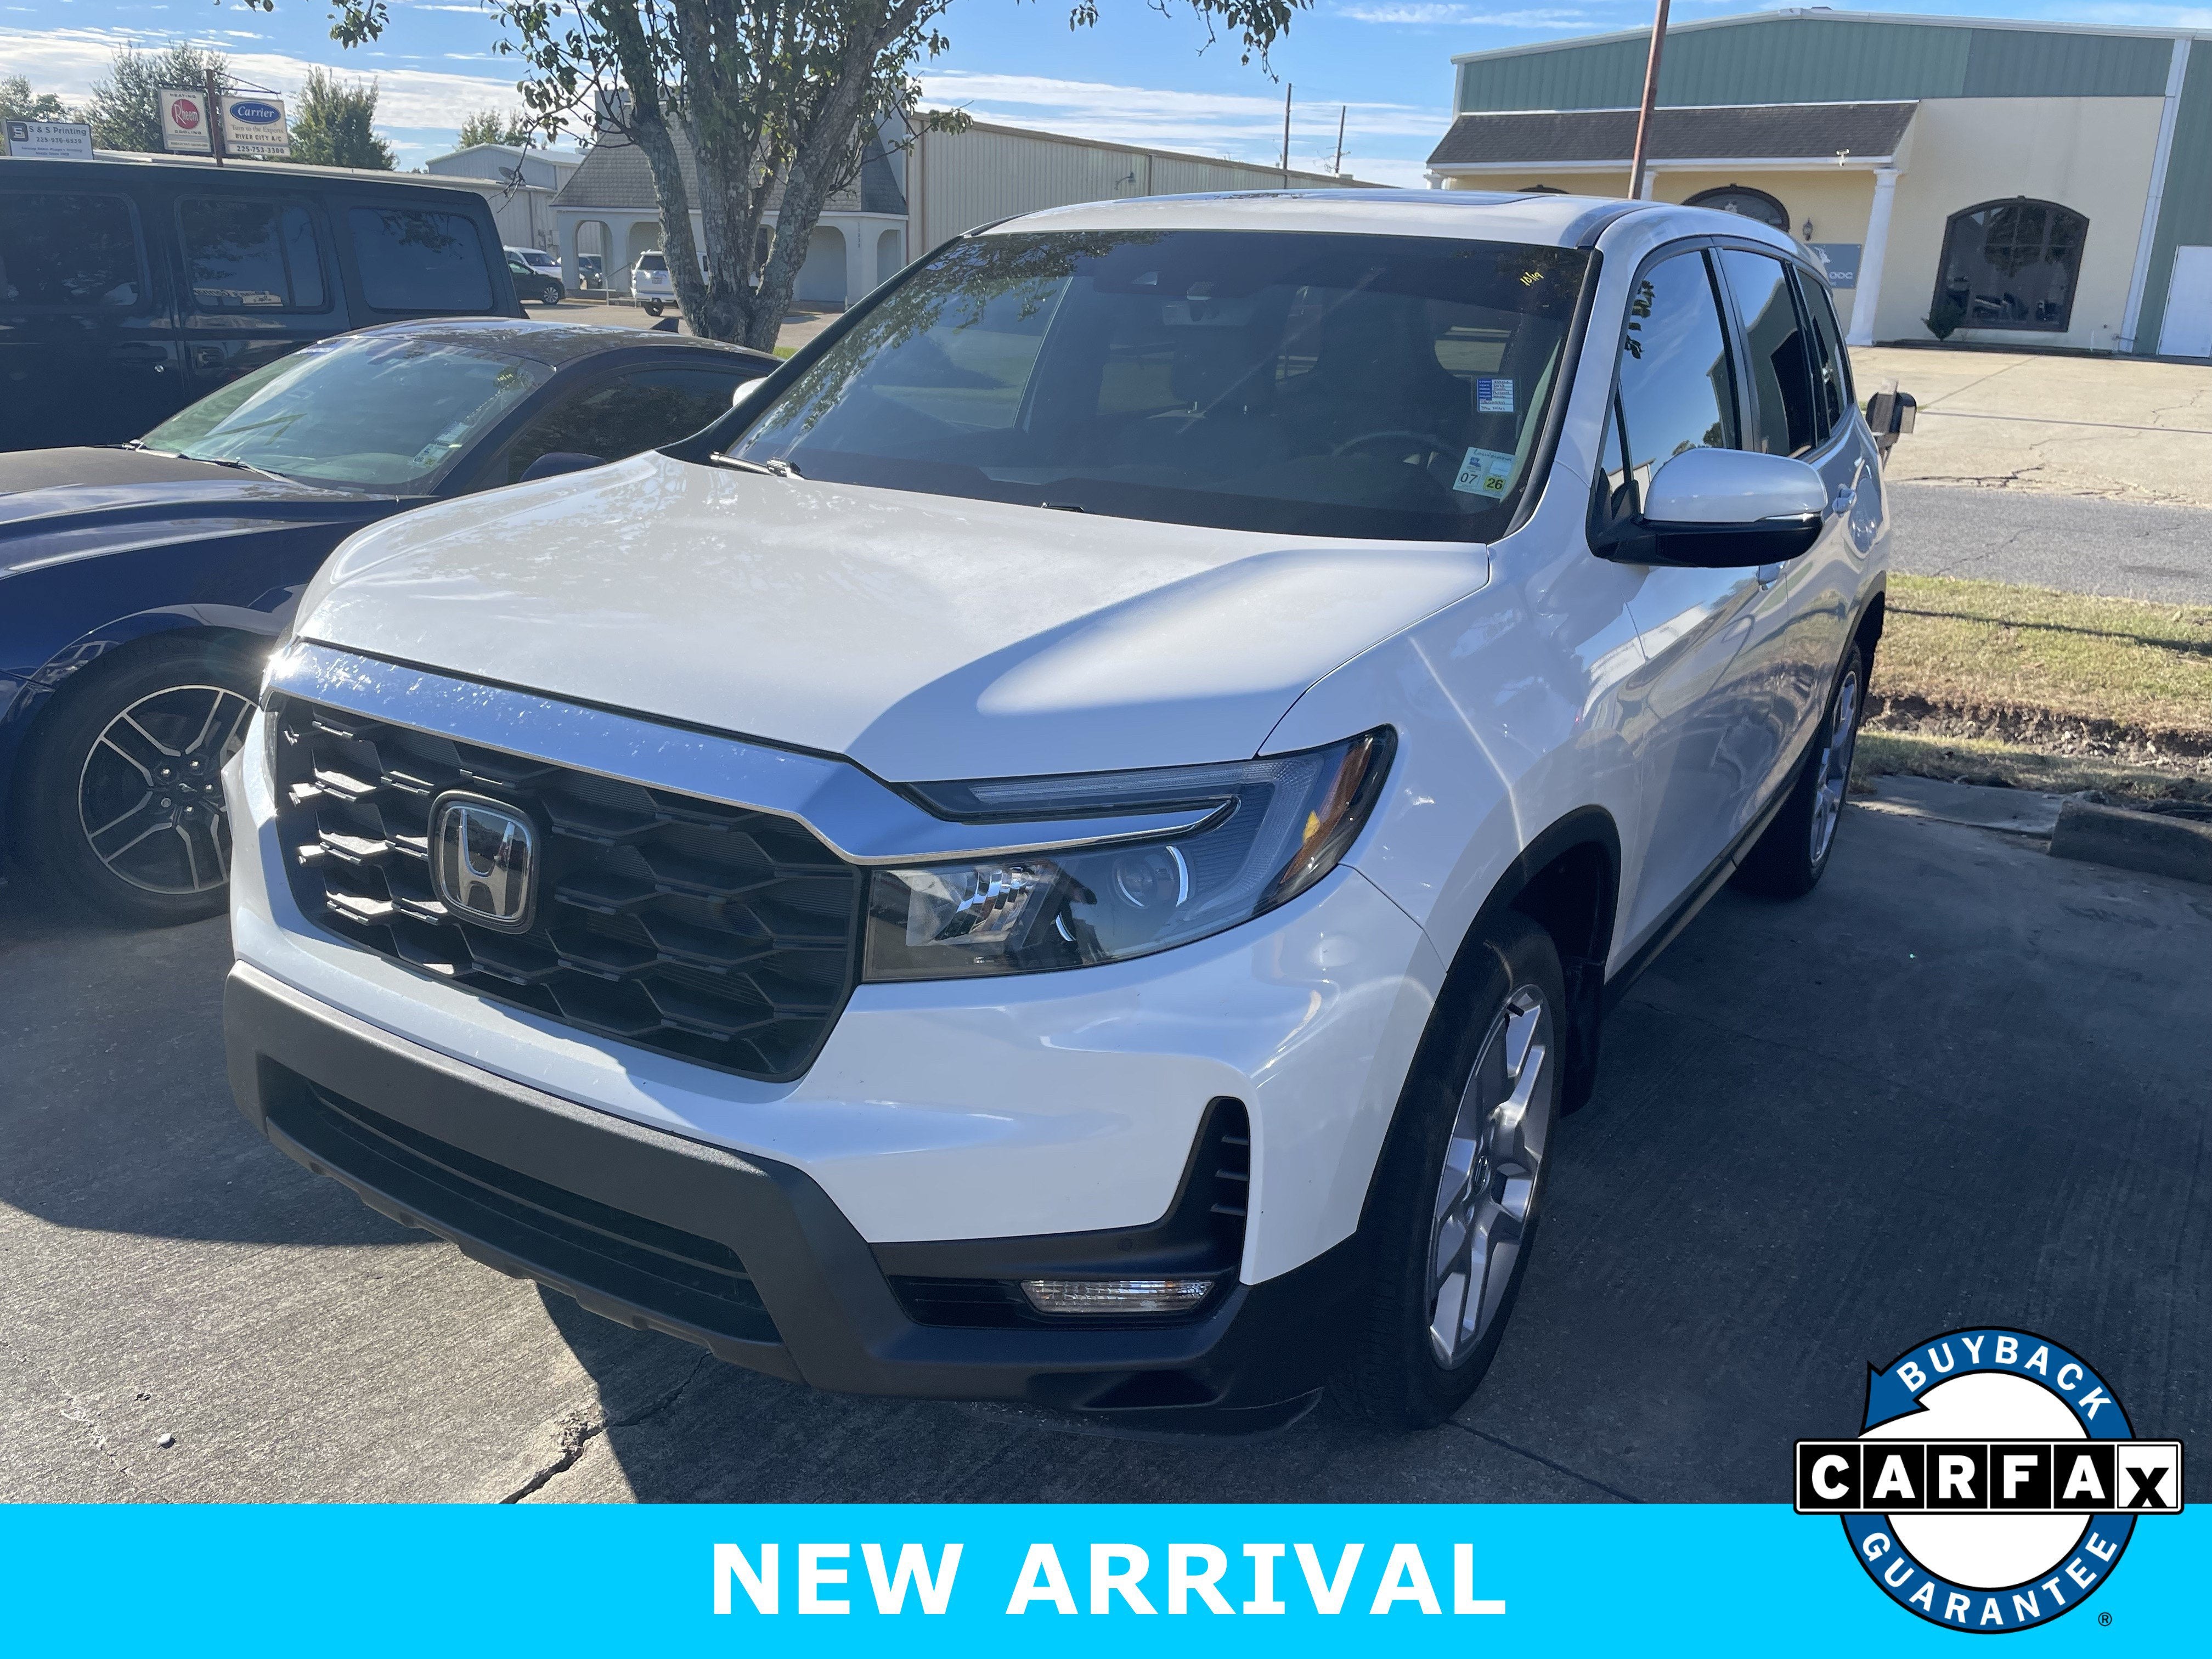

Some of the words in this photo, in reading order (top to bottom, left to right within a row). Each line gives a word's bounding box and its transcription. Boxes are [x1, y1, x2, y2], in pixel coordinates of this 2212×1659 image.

[174, 100, 198, 125] Rheem
[238, 106, 274, 117] Carrier
[53, 127, 87, 136] Printing
[237, 145, 284, 154] 225-753-3300
[1460, 472, 1479, 484] 07
[1486, 478, 1504, 489] 26
